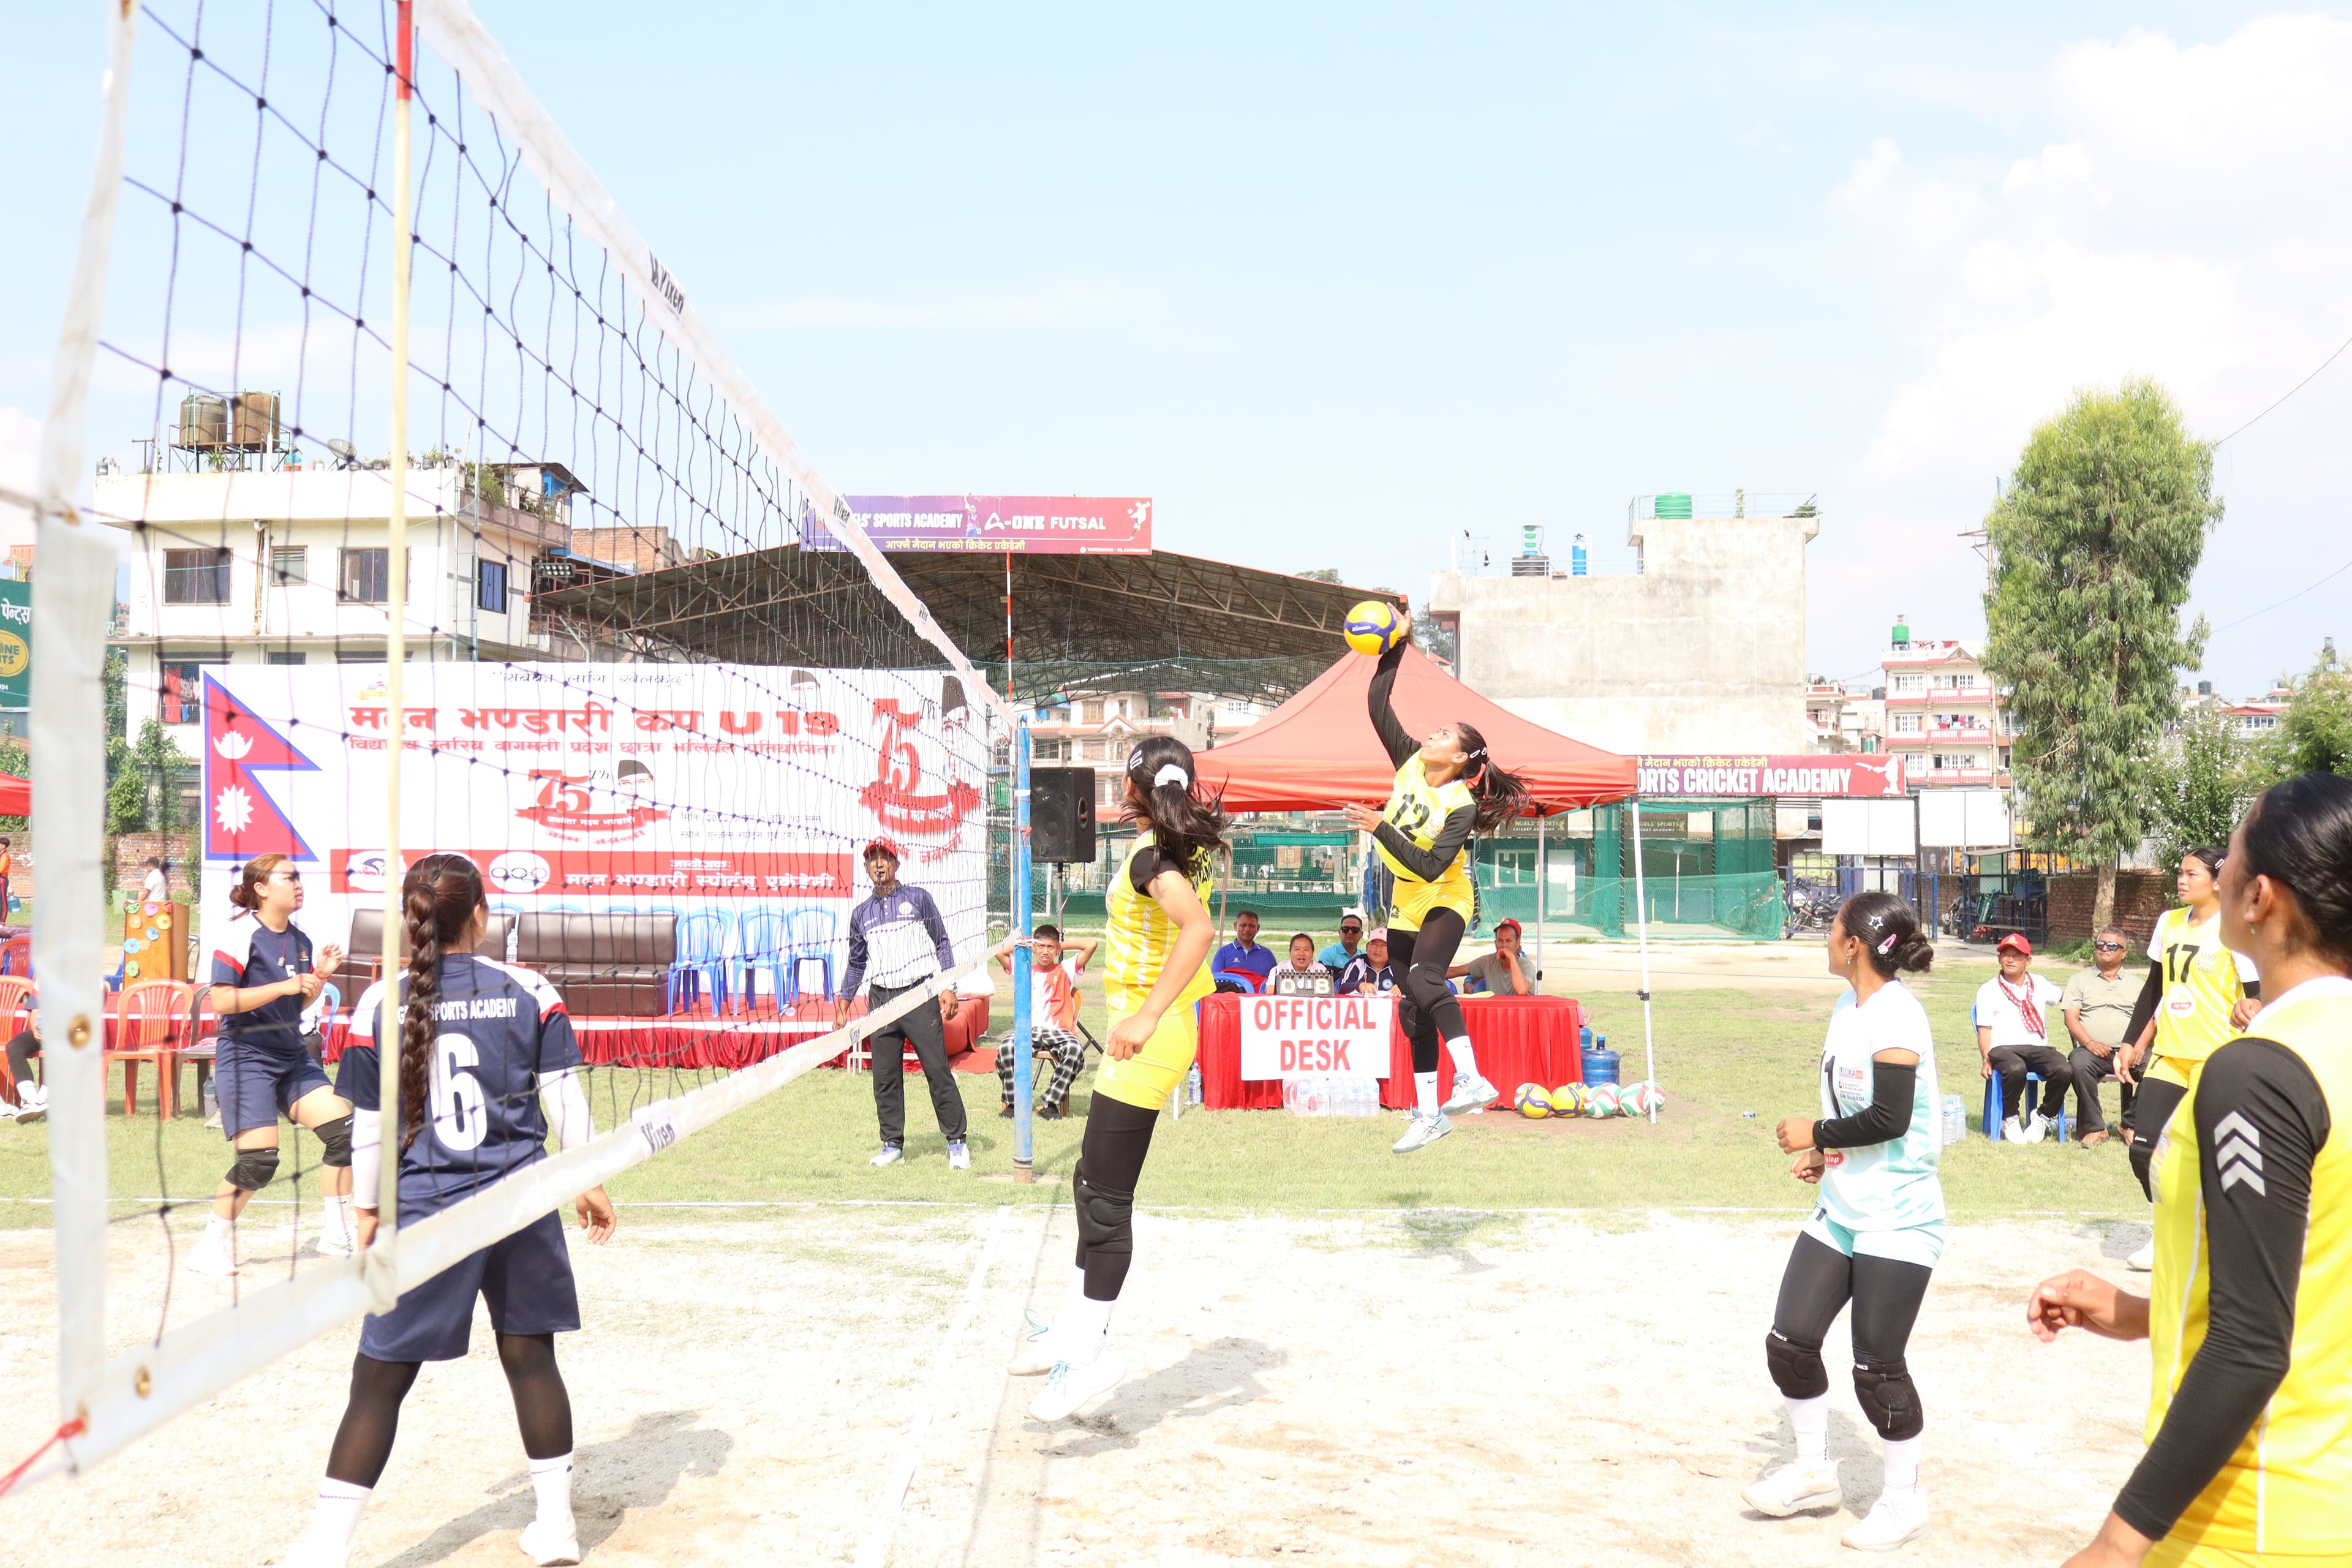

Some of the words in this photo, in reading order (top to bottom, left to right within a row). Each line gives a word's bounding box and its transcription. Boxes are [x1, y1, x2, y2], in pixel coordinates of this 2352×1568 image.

[873, 513, 911, 527] SPORTS
[913, 513, 963, 528] ACADEMY
[1050, 517, 1106, 530] FUTSAL
[912, 538, 936, 549] मैदान
[938, 539, 963, 549] भएको
[965, 538, 993, 550] क्रिकेट
[458, 702, 614, 737] भण्डारी
[633, 710, 702, 733] कप
[720, 711, 762, 734] U
[775, 710, 840, 736] 19
[570, 739, 610, 754] प्रदेश
[619, 742, 663, 754] छात्रा
[1645, 756, 1671, 767] मैदान
[1673, 756, 1701, 767] भएको
[1702, 756, 1732, 768] क्रिकेट
[528, 769, 590, 813] 75
[1683, 768, 1758, 794] CRICKET
[1762, 768, 1852, 793] ACADEMY
[1391, 794, 1430, 842] 12
[565, 874, 608, 888] मदन
[615, 871, 689, 888] भण्डारी
[2166, 943, 2200, 983] 17
[1316, 978, 1330, 994] 8
[470, 998, 516, 1019] ACADEMY
[1254, 999, 1377, 1031] OFFICIAL
[1280, 1039, 1351, 1071] DESK
[429, 1033, 488, 1151] 6
